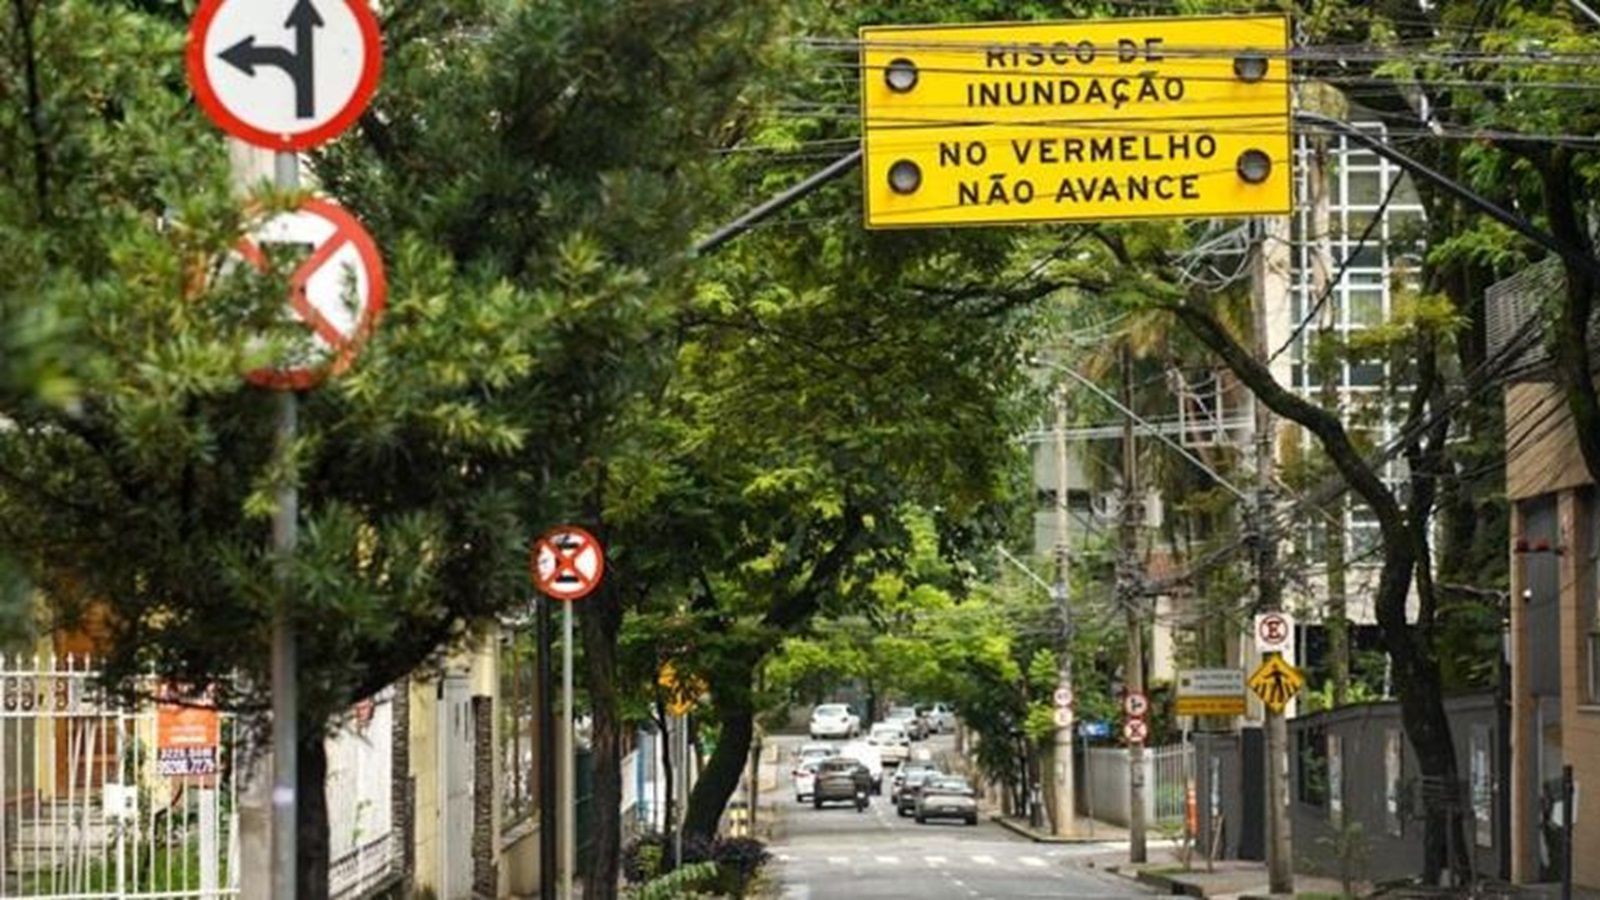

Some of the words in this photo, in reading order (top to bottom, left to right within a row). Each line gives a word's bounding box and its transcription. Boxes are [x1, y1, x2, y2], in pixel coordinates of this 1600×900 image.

[985, 40, 1096, 68] RISCO
[1118, 38, 1164, 64] DE
[967, 71, 1185, 110] INUNDAÇÃO
[939, 140, 988, 168] NO
[1011, 134, 1217, 165] VERMELHO
[957, 173, 1035, 206] NÃO
[1054, 174, 1200, 203] AVANCE
